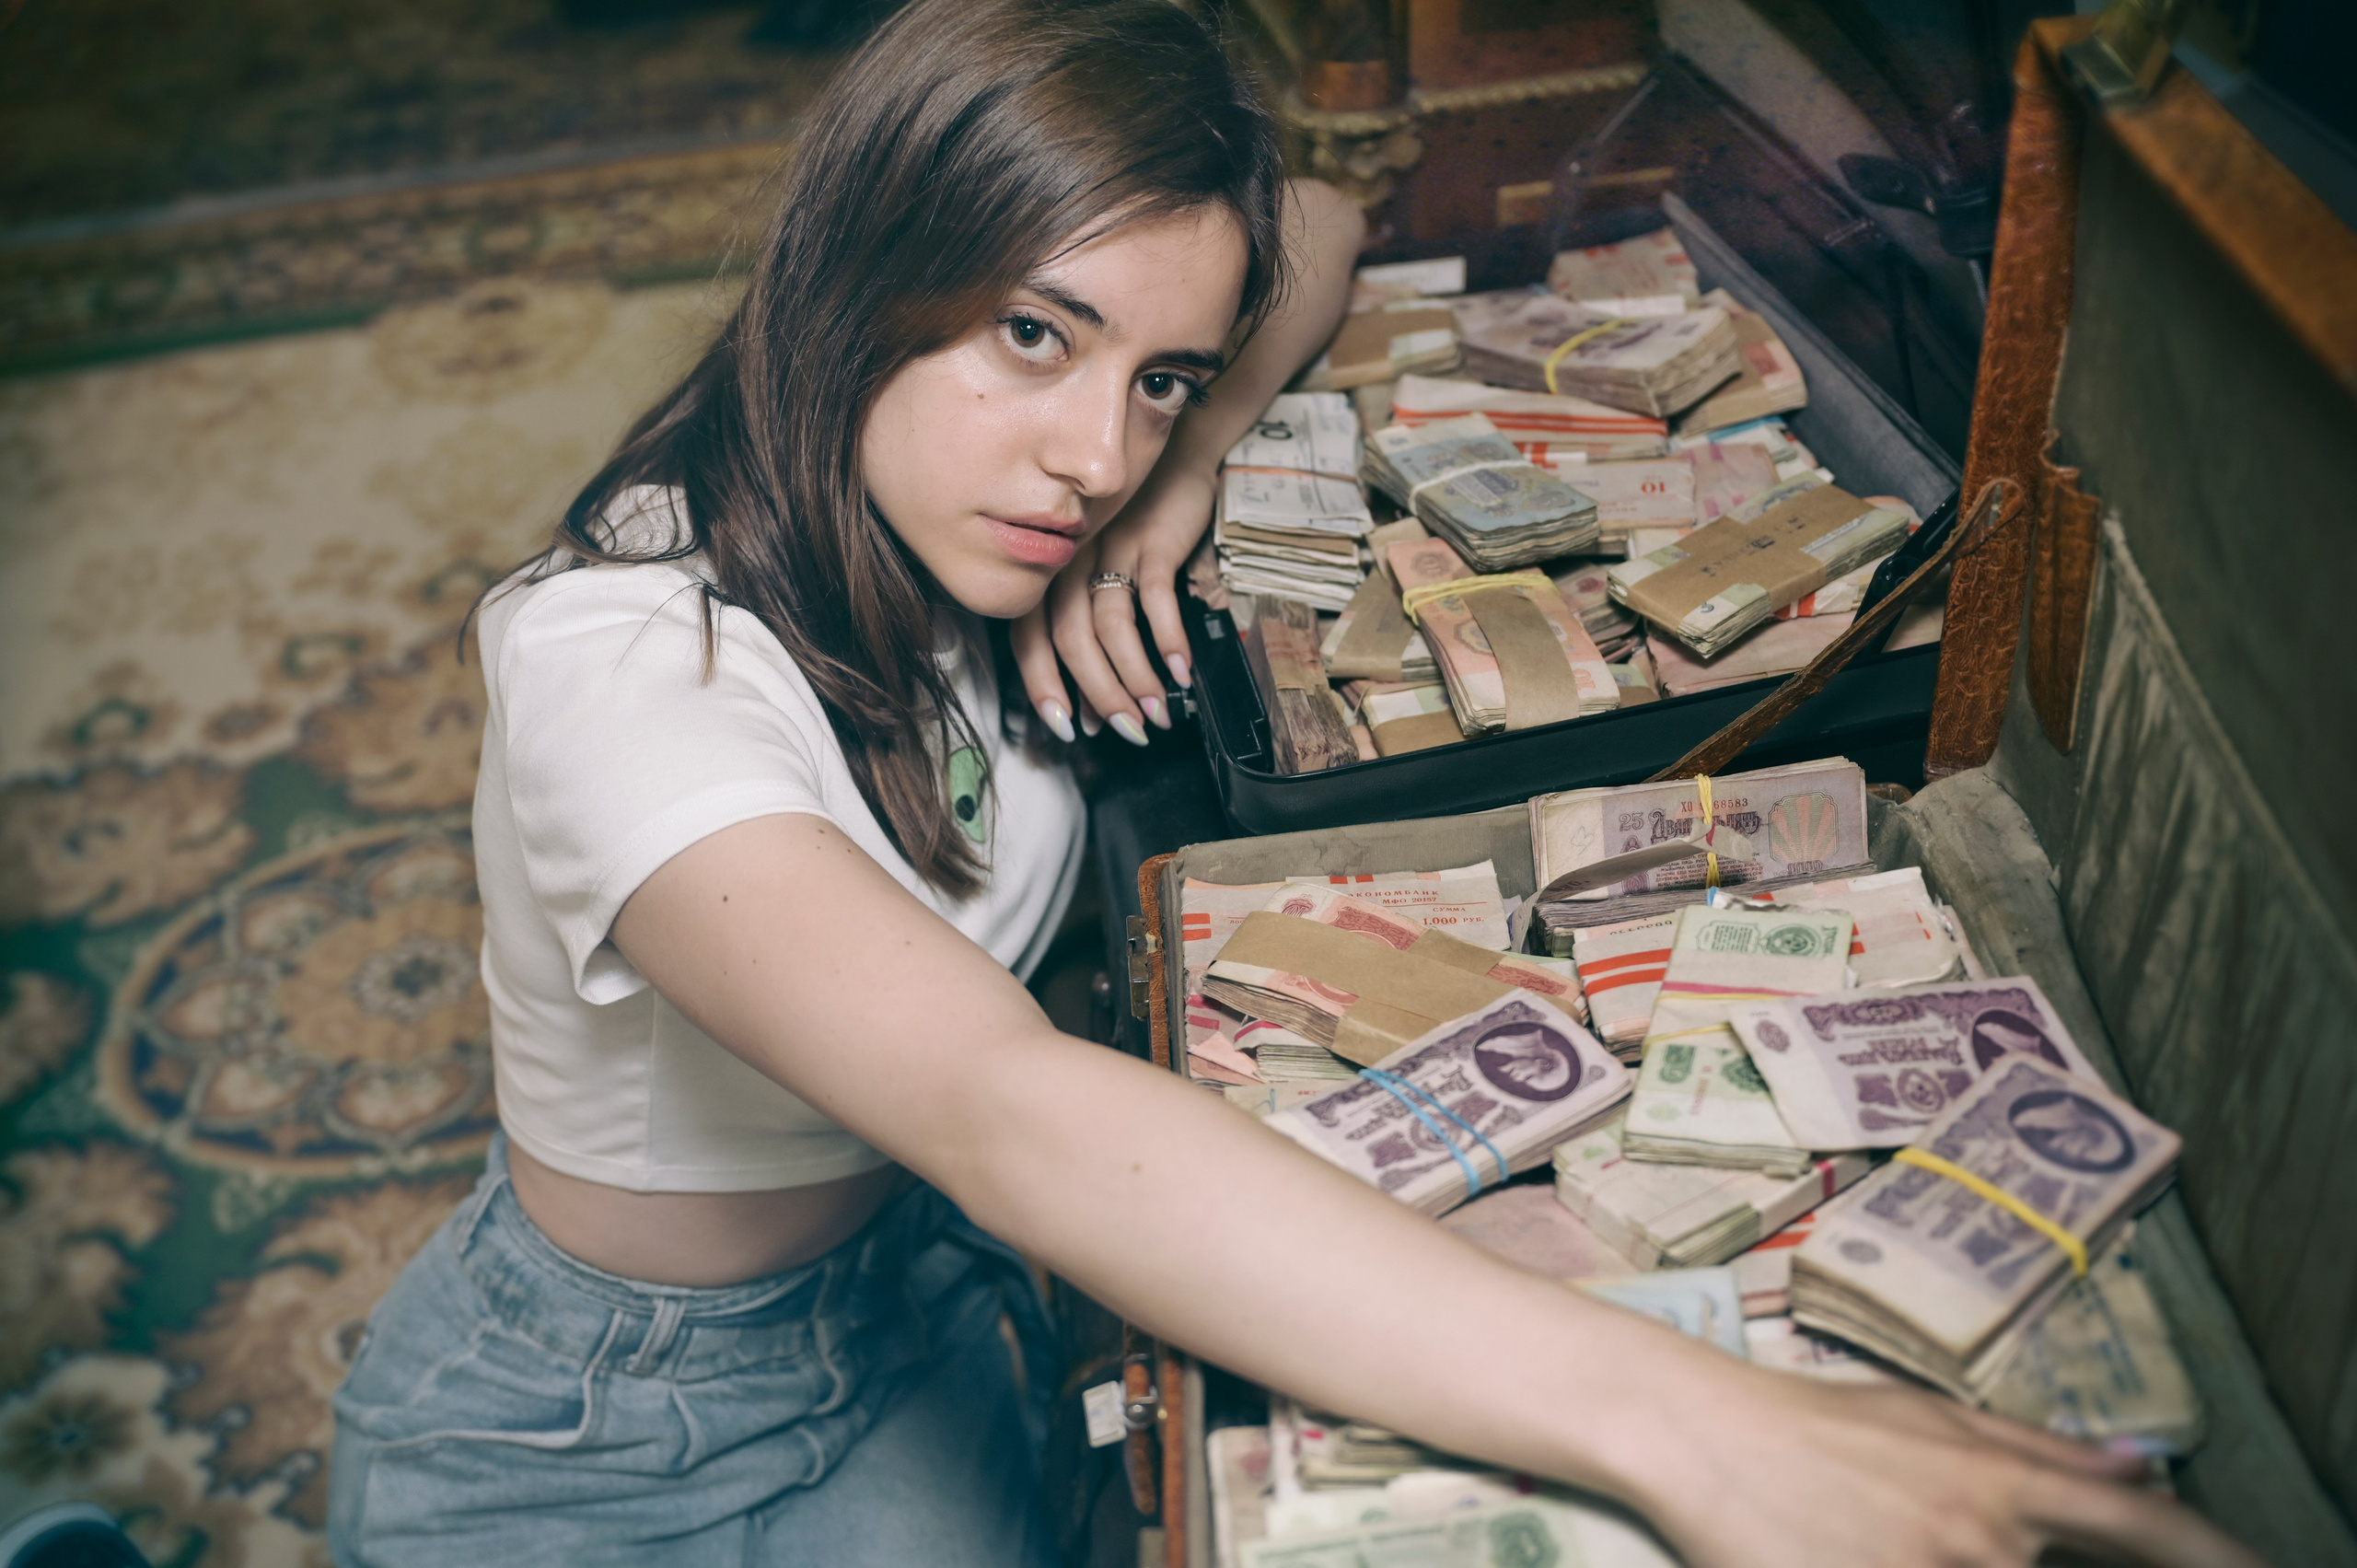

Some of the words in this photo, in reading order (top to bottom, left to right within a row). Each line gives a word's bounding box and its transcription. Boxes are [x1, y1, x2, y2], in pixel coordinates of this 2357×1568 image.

[1699, 798, 1748, 811] 68583
[1619, 812, 1644, 831] 25
[1422, 917, 1457, 925] 1.000
